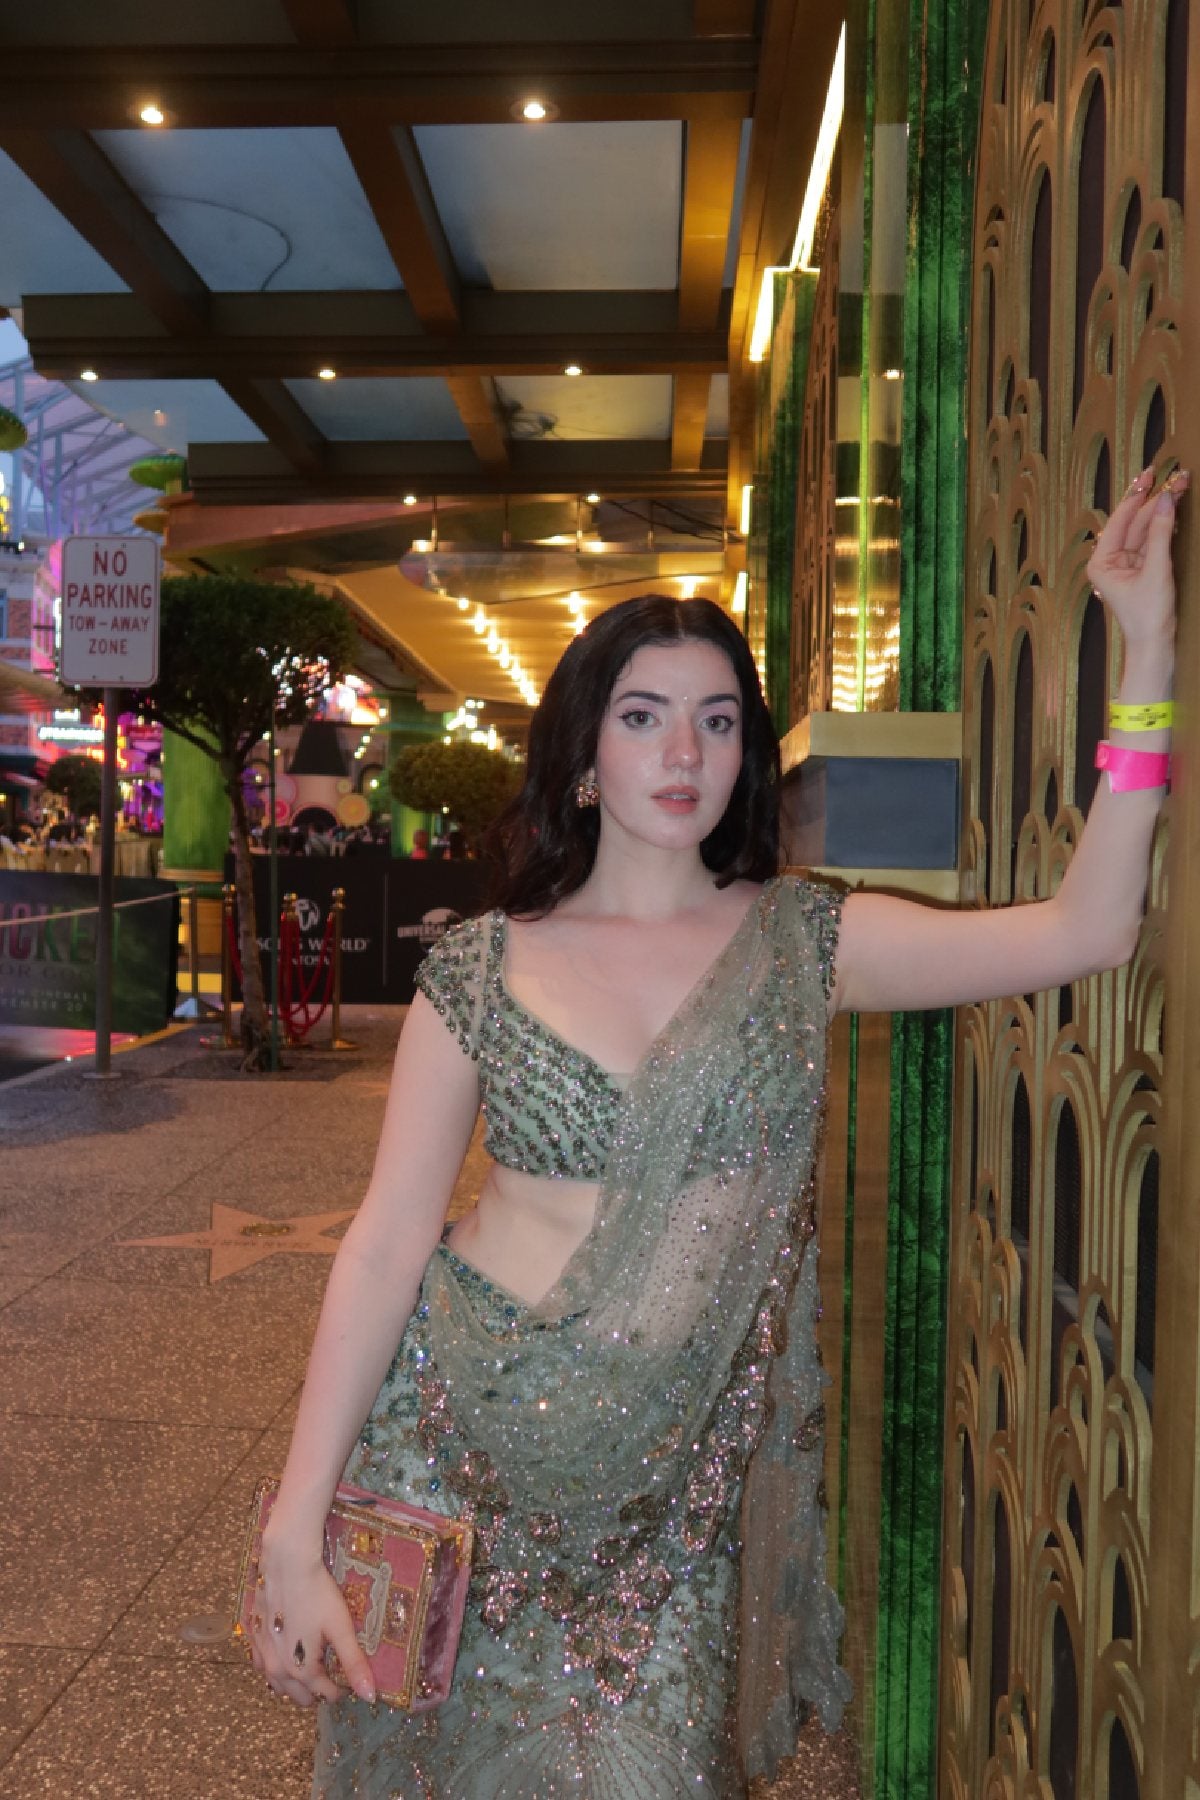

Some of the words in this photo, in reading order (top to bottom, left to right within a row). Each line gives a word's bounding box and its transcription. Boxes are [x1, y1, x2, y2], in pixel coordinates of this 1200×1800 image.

[93, 550, 127, 576] NO
[67, 583, 152, 609] PARKING
[88, 638, 128, 656] ZONE
